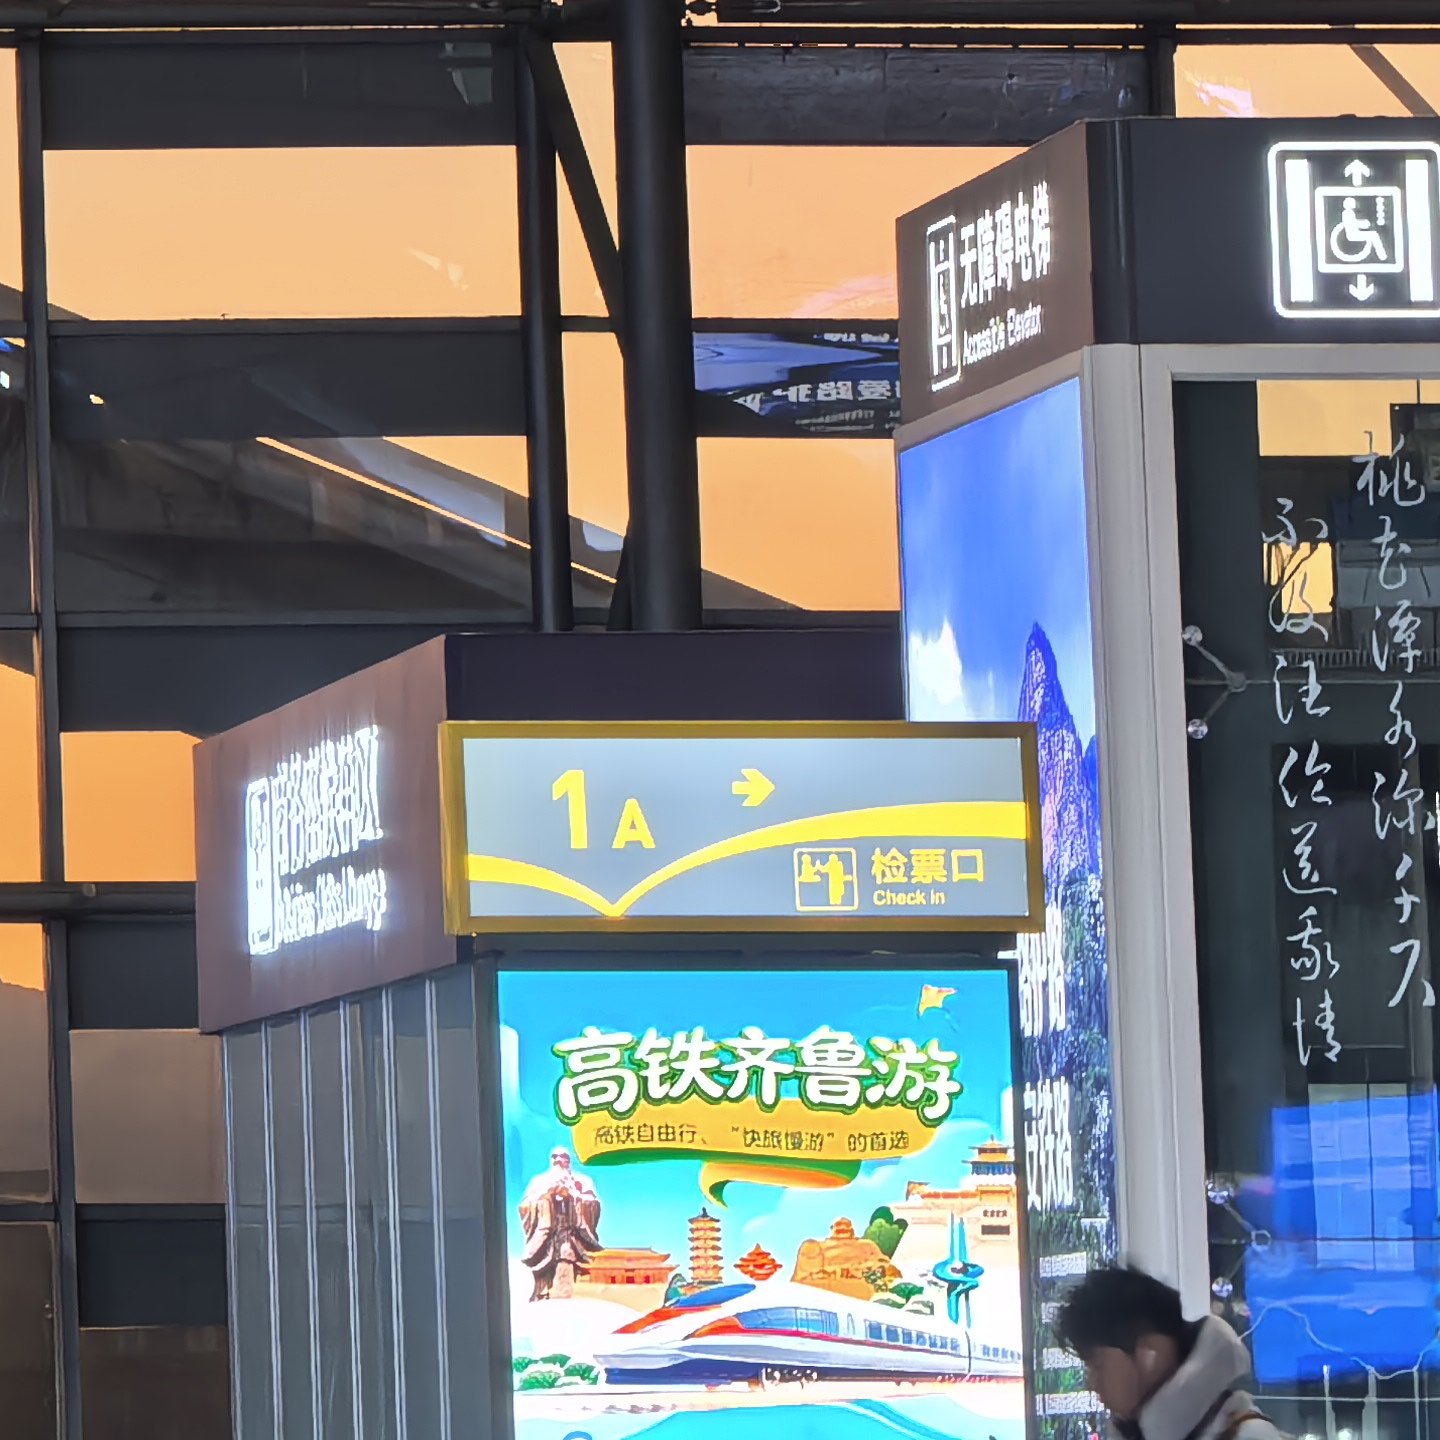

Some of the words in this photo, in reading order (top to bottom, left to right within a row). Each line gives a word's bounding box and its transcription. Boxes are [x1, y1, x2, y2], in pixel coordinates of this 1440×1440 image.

[959, 180, 1051, 308] 无障碍电梯
[871, 847, 984, 884] 检票口
[873, 888, 927, 906] Check
[553, 1025, 963, 1123] 高铁齐鲁游
